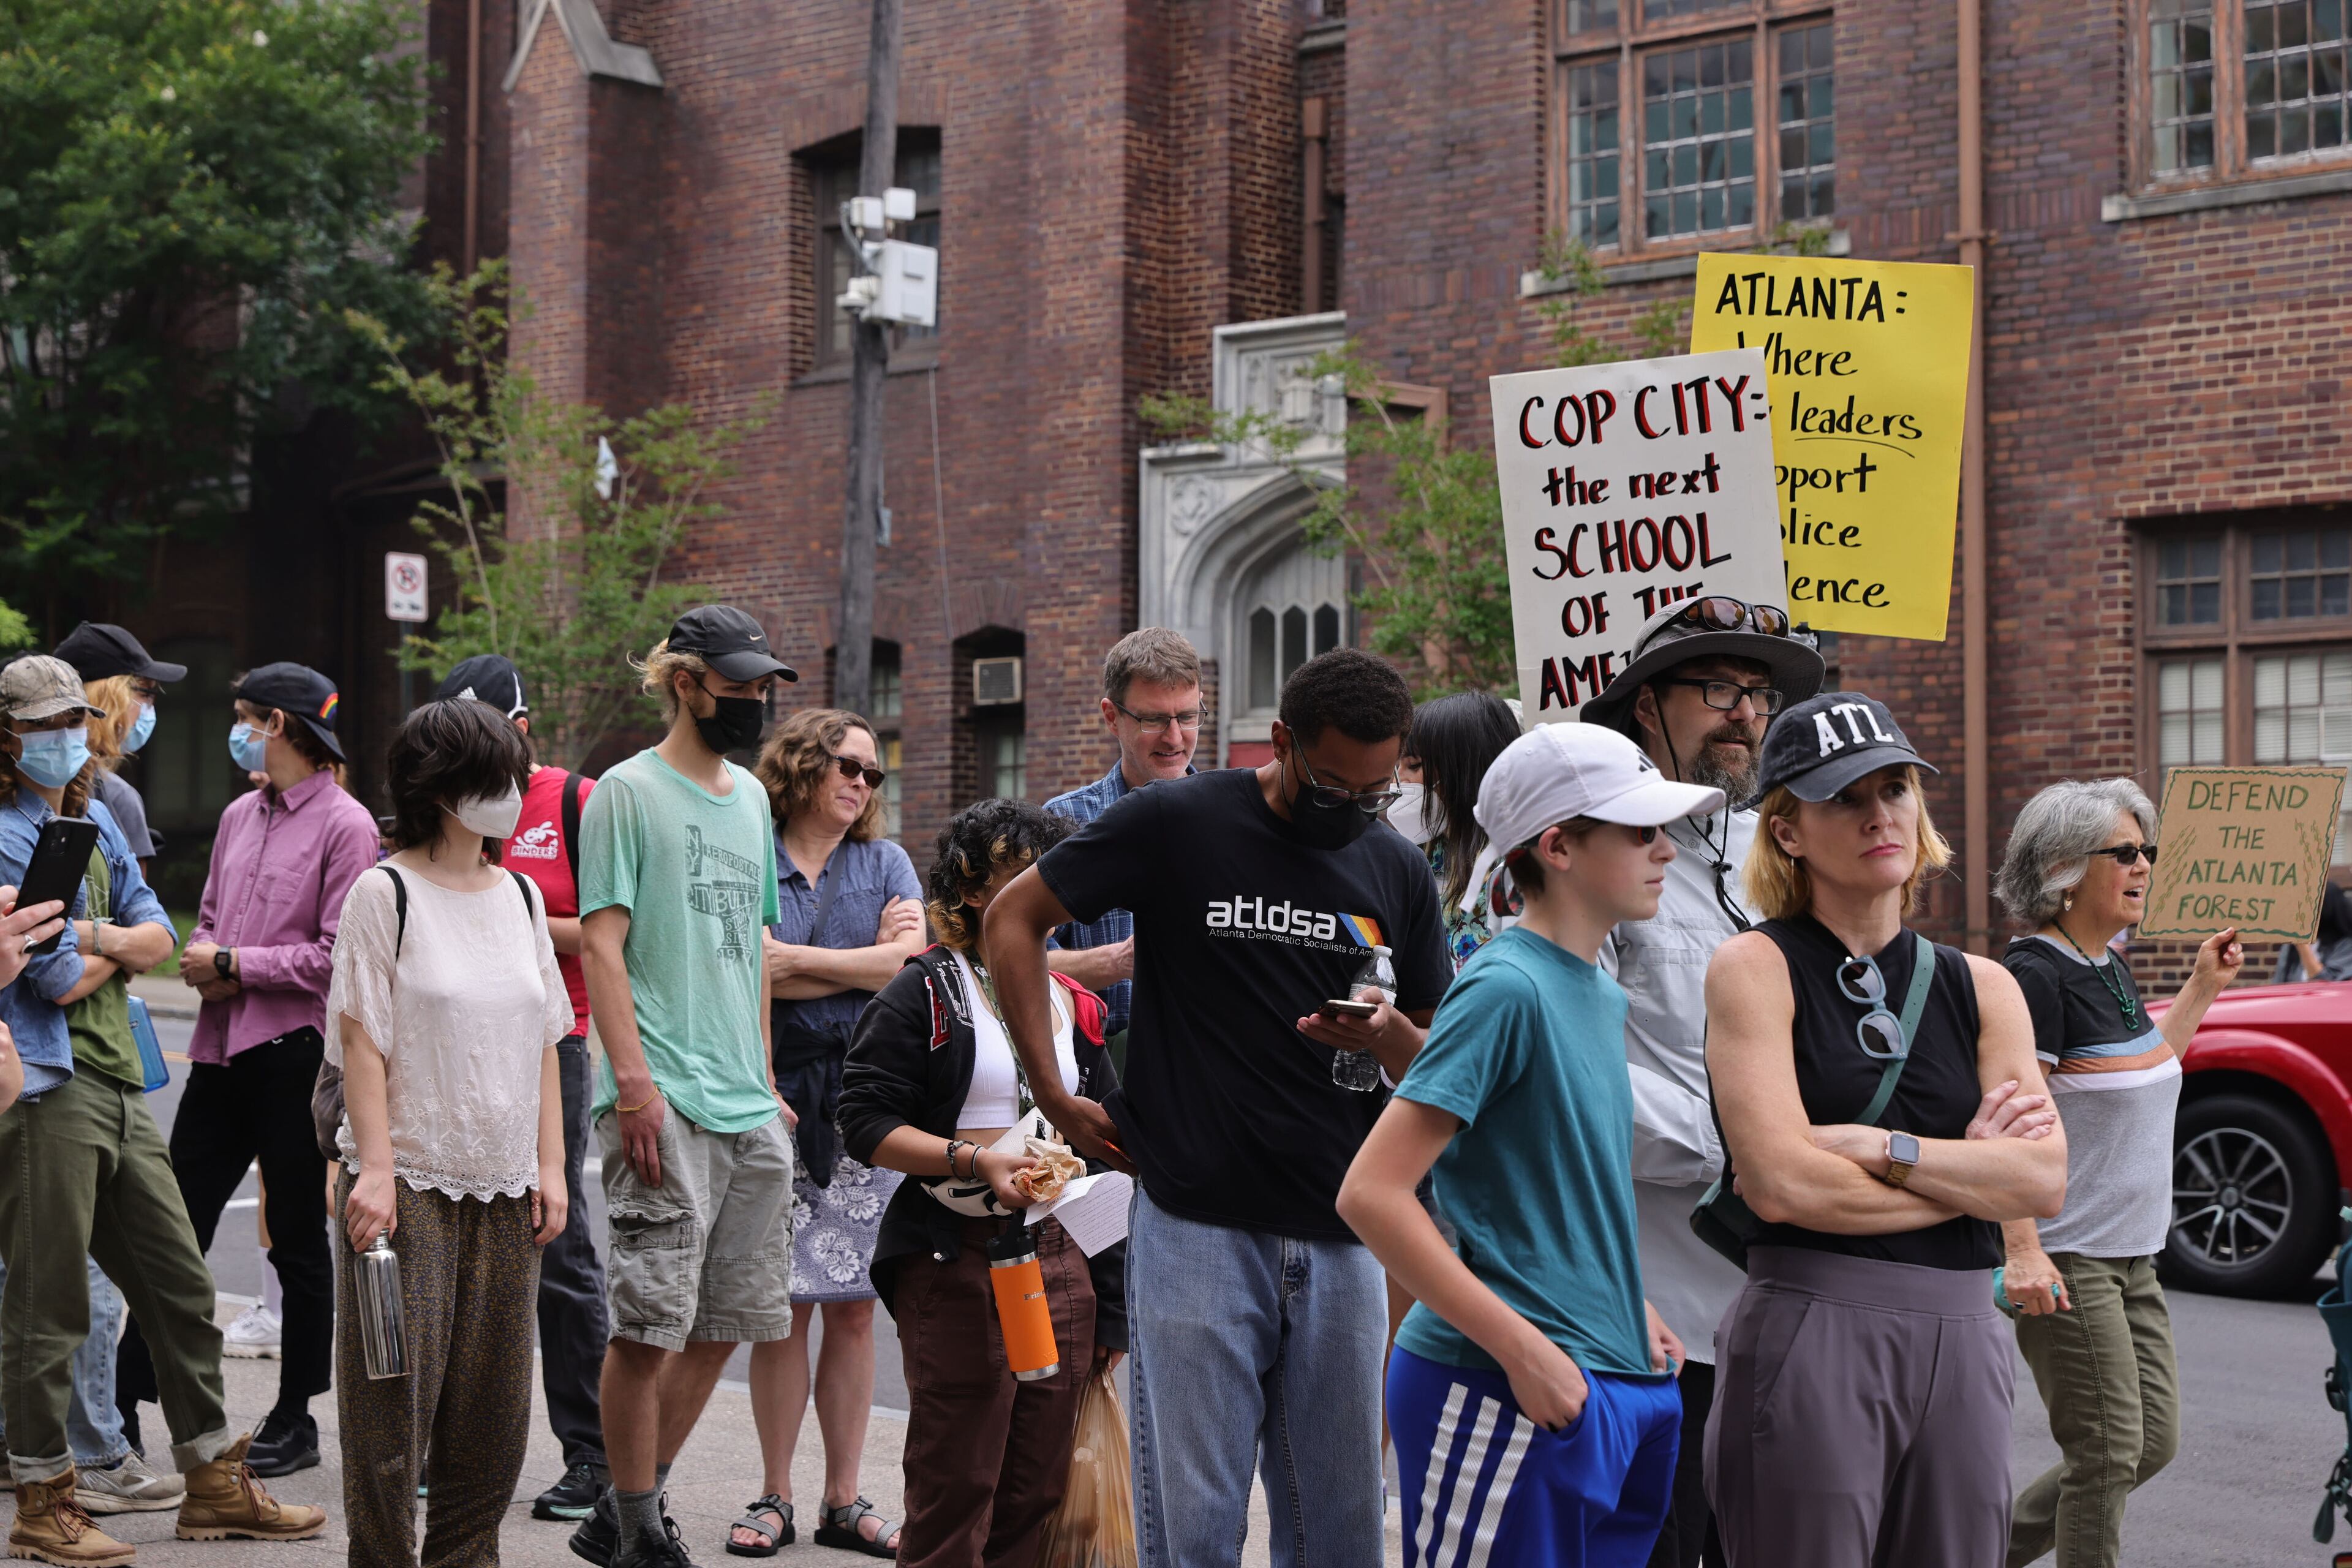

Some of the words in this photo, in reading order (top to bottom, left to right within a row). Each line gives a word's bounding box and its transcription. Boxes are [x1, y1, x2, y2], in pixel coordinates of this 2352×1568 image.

[1715, 272, 1907, 323] ATLANTA:
[1519, 390, 1616, 448] COP
[1790, 391, 1923, 439] leaders
[1542, 465, 1610, 507] the
[1629, 452, 1721, 500] next
[1532, 511, 1732, 580] SCHOOL
[1561, 590, 1610, 638] OF
[1812, 703, 1894, 758] ATL
[2187, 780, 2309, 812] DEFEND
[513, 847, 556, 856] BINDERS
[2218, 826, 2265, 850] THE
[2186, 859, 2297, 886] ATLANTA
[1206, 895, 1336, 940] atldsa
[2176, 893, 2275, 921] FOREST
[1209, 929, 1245, 938] Atlanta
[1248, 930, 1300, 945] Democratic
[1303, 937, 1346, 953] Socialists
[1349, 946, 1358, 955] of
